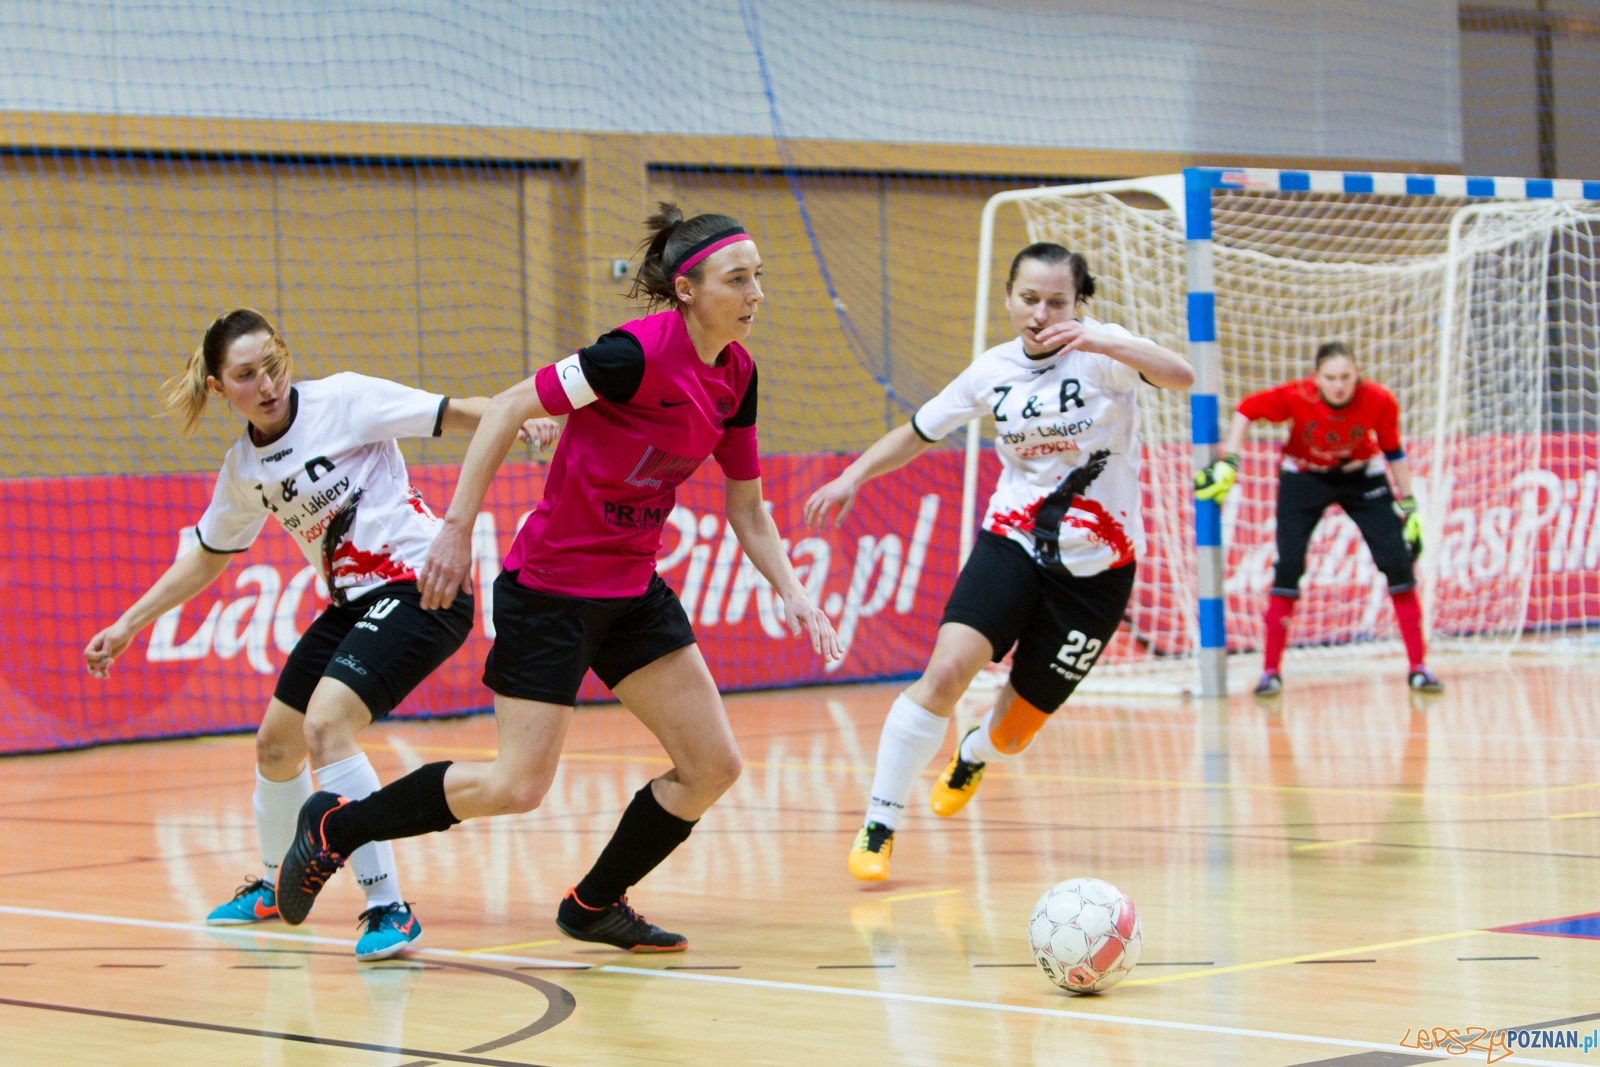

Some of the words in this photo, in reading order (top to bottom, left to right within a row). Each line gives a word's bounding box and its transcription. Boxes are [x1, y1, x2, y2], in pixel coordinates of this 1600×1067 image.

[993, 386, 1013, 422] Z
[1022, 395, 1044, 419] &
[1060, 378, 1085, 413] R
[1037, 417, 1094, 438] Lakiery
[260, 447, 294, 465] regio
[1056, 630, 1102, 671] 22
